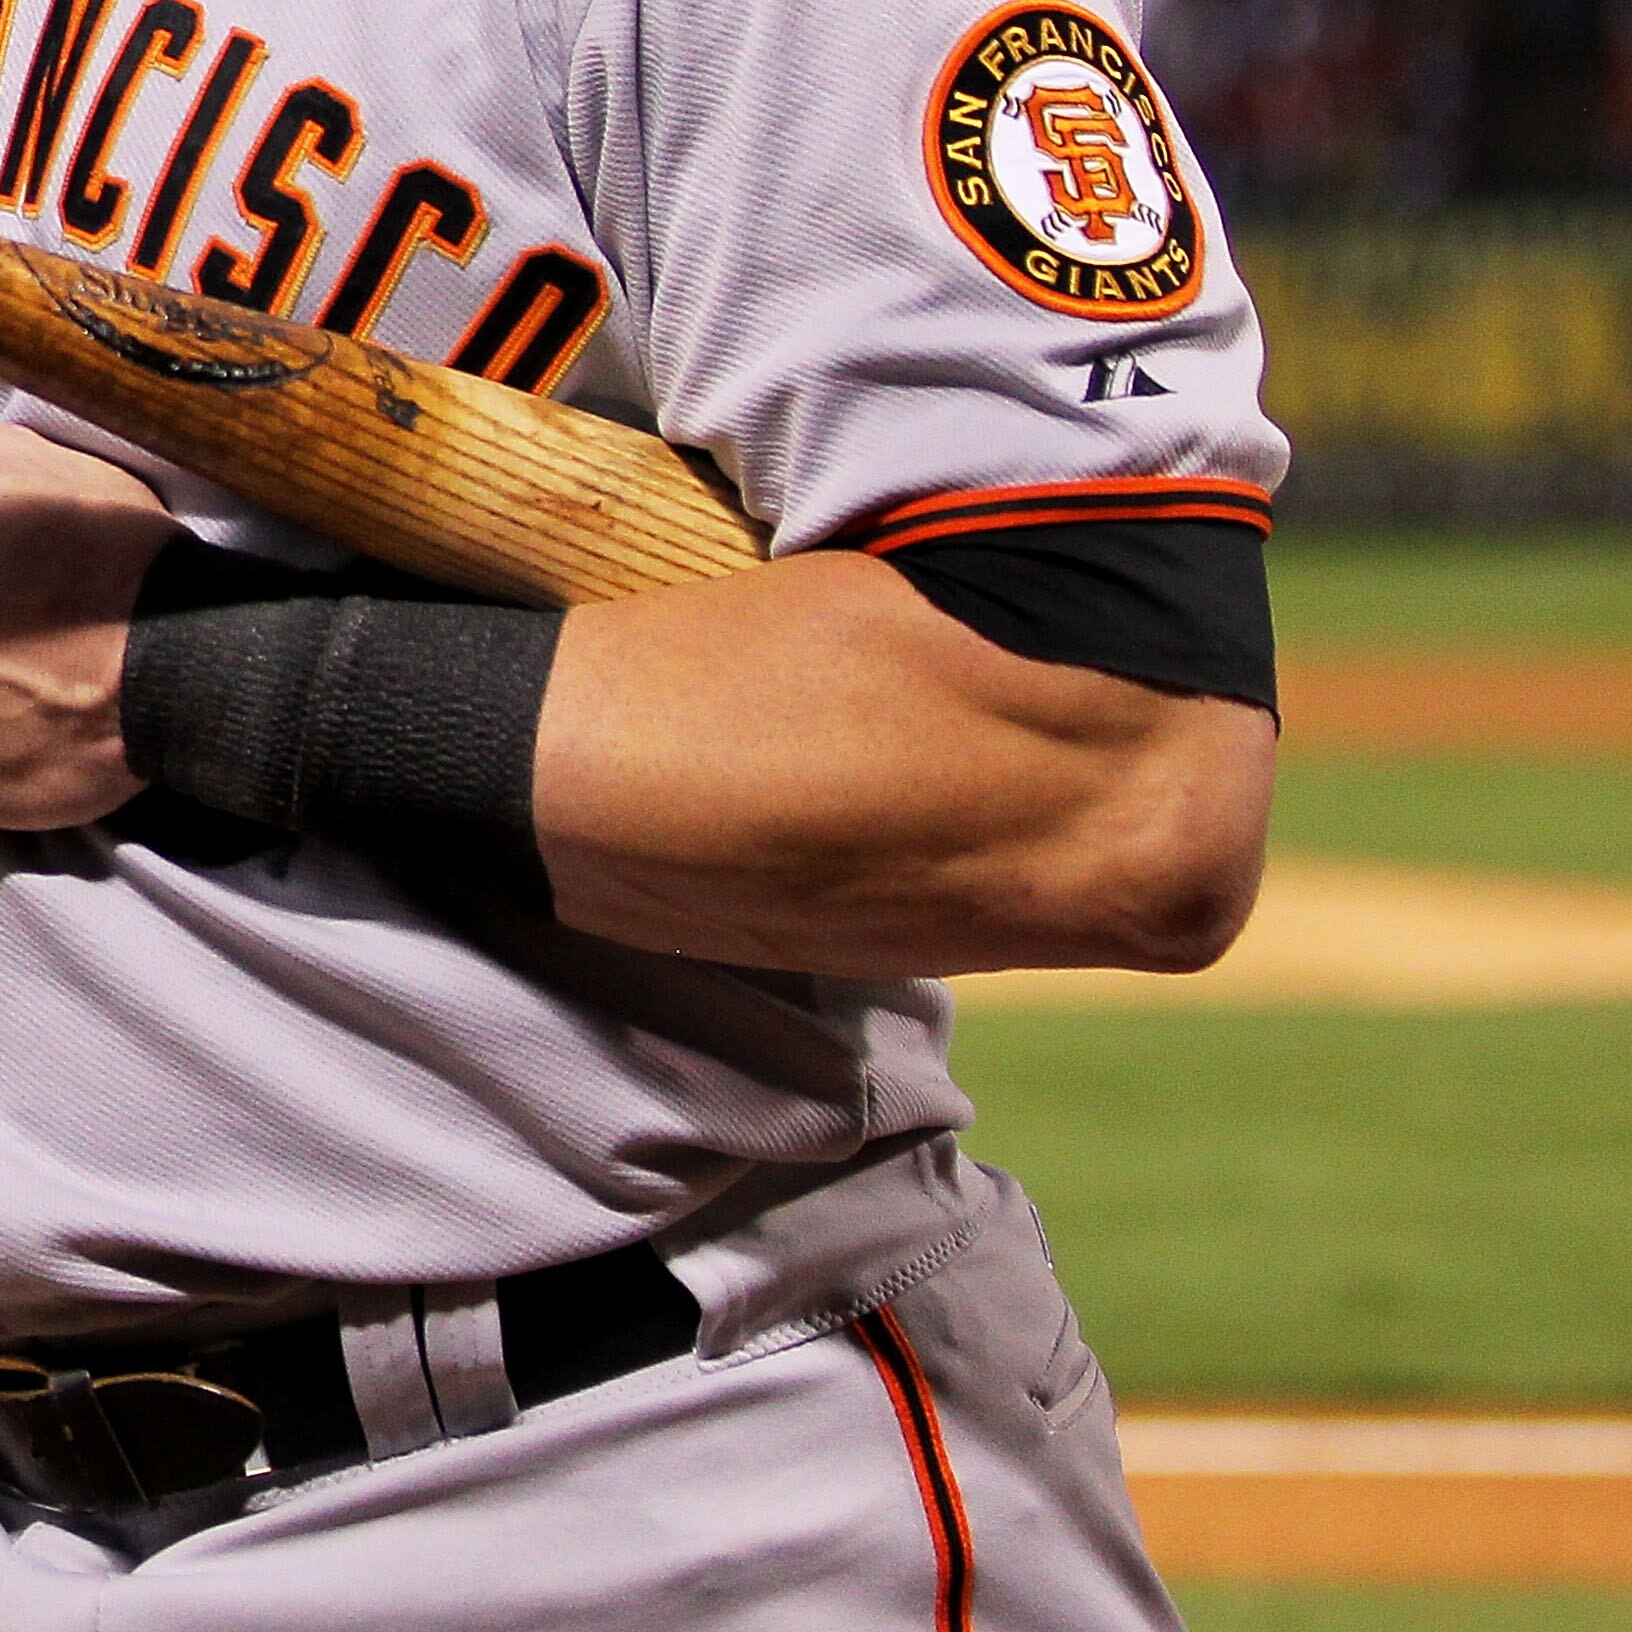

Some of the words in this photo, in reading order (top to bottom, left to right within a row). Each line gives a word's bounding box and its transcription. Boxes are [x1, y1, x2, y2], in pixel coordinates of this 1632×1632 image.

[946, 90, 992, 207] SAN
[977, 17, 1184, 204] FRANCISCO
[1024, 237, 1191, 301] GIANTS
